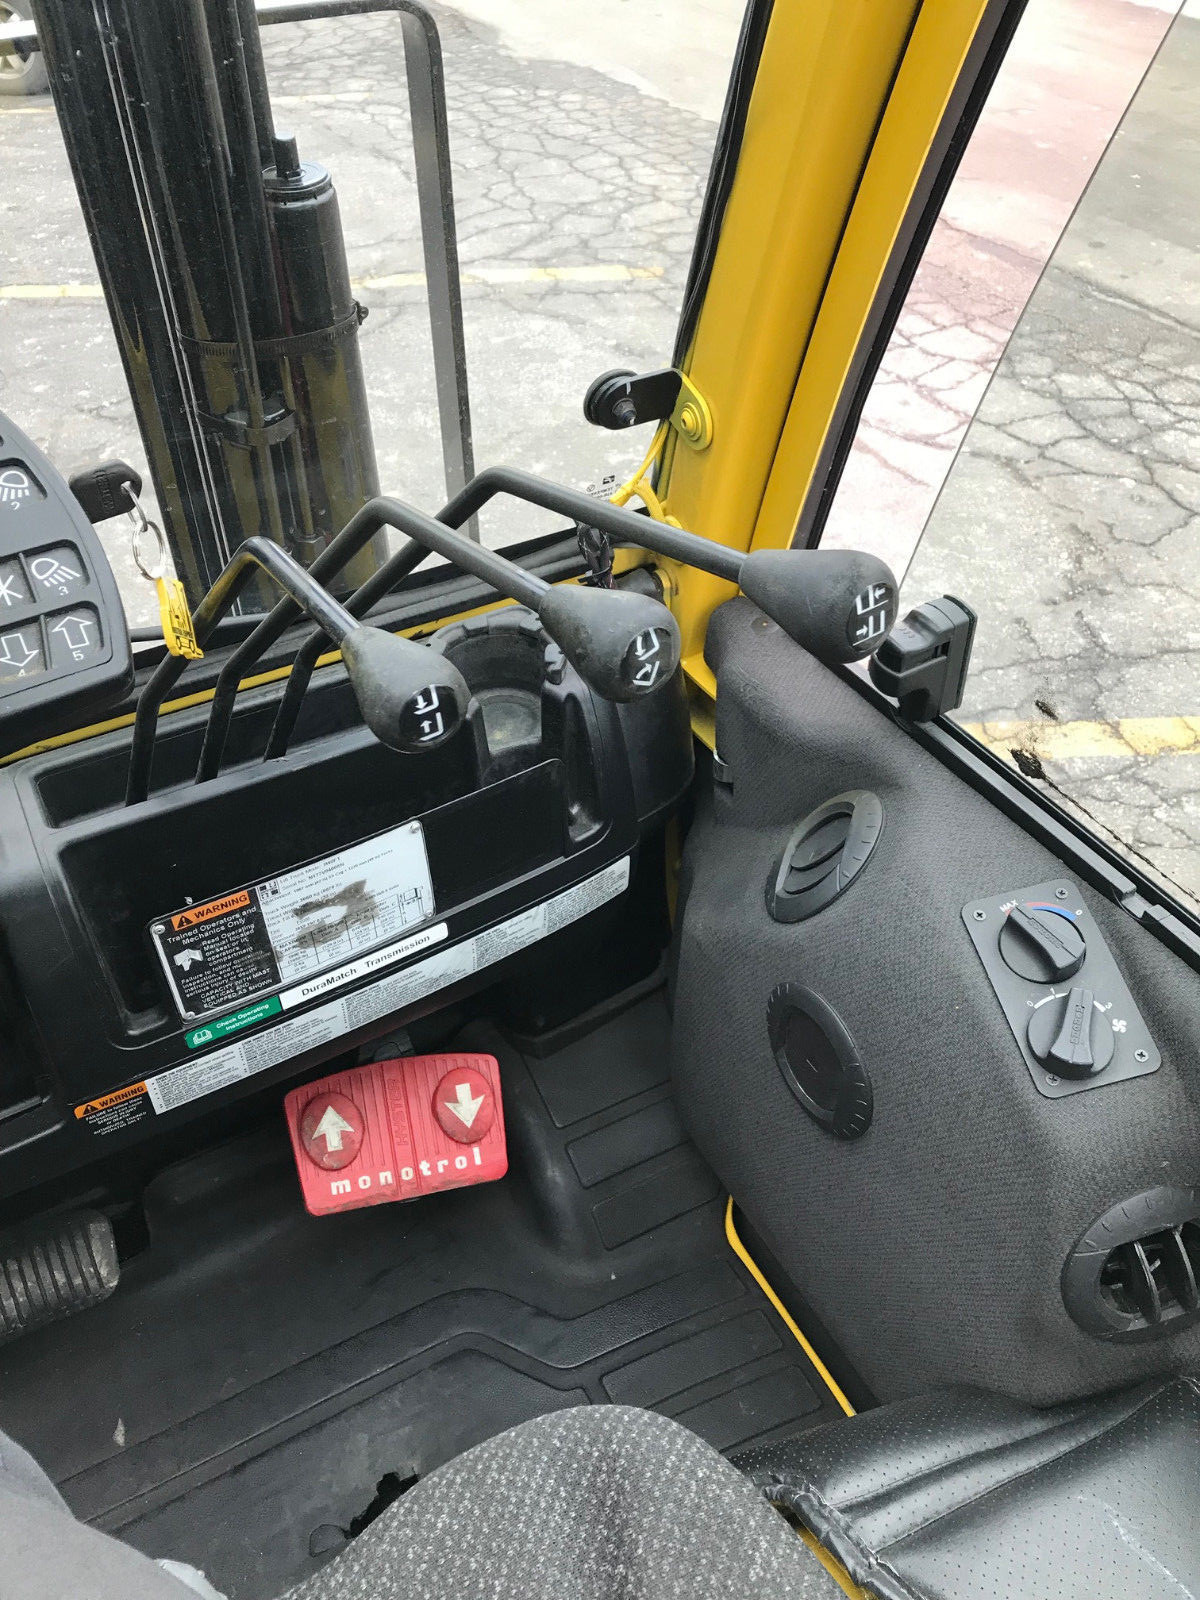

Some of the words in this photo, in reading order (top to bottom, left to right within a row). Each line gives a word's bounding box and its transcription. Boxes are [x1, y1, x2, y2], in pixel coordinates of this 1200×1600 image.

[59, 586, 69, 595] 3
[72, 650, 84, 661] 5
[194, 895, 247, 919] WARNING
[1000, 899, 1019, 914] MAX
[167, 929, 198, 943] Trained
[199, 913, 240, 932] Operators
[241, 907, 256, 916] and
[182, 925, 225, 945] Mechanics
[227, 917, 246, 928] Only
[201, 936, 219, 946] Read
[220, 923, 255, 940] Operating
[203, 939, 228, 951] Manual
[229, 929, 254, 941] located
[208, 947, 253, 967] compartment
[301, 967, 357, 997] DuraMatch
[364, 934, 430, 969] Transmission
[181, 973, 203, 984] Failure
[212, 962, 232, 972] follow
[200, 983, 234, 999] CAPACITY
[235, 976, 251, 985] WITH
[252, 968, 271, 978] MAST
[202, 988, 235, 1003] VERTICAL
[235, 982, 249, 990] AND
[203, 992, 236, 1007] EQUIPPED
[248, 979, 273, 990] SHOWN
[216, 1015, 237, 1030] Check
[238, 1003, 270, 1022] Operating
[225, 1012, 264, 1030] Instructions
[99, 1086, 144, 1107] WARNING
[331, 1147, 482, 1196] monotrol
